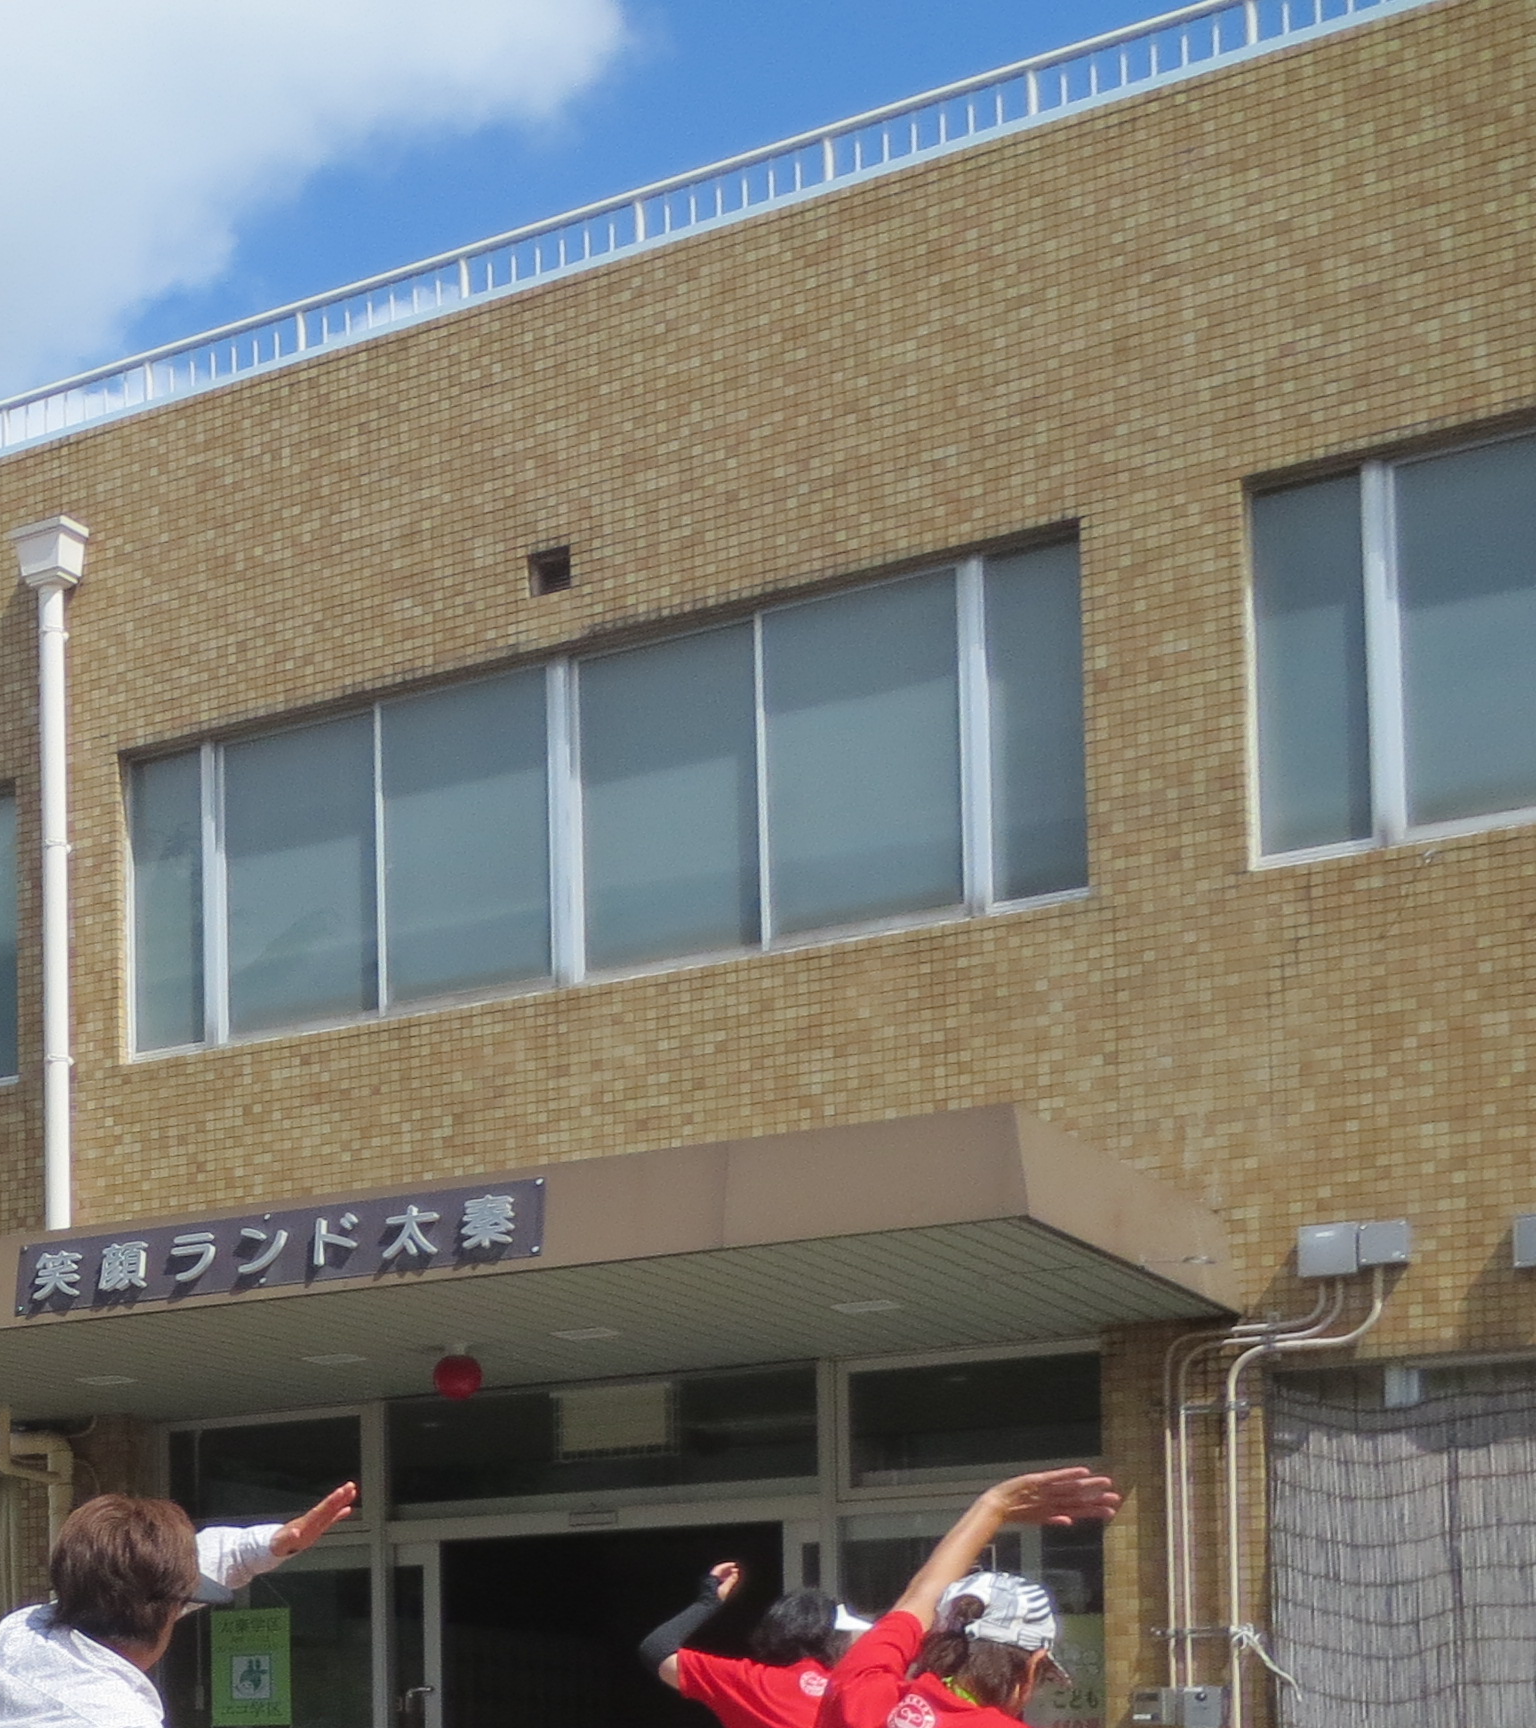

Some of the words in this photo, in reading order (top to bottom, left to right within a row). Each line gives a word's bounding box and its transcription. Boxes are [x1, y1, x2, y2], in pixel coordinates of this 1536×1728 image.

[33, 1194, 516, 1300] 笑顔ランド太秦
